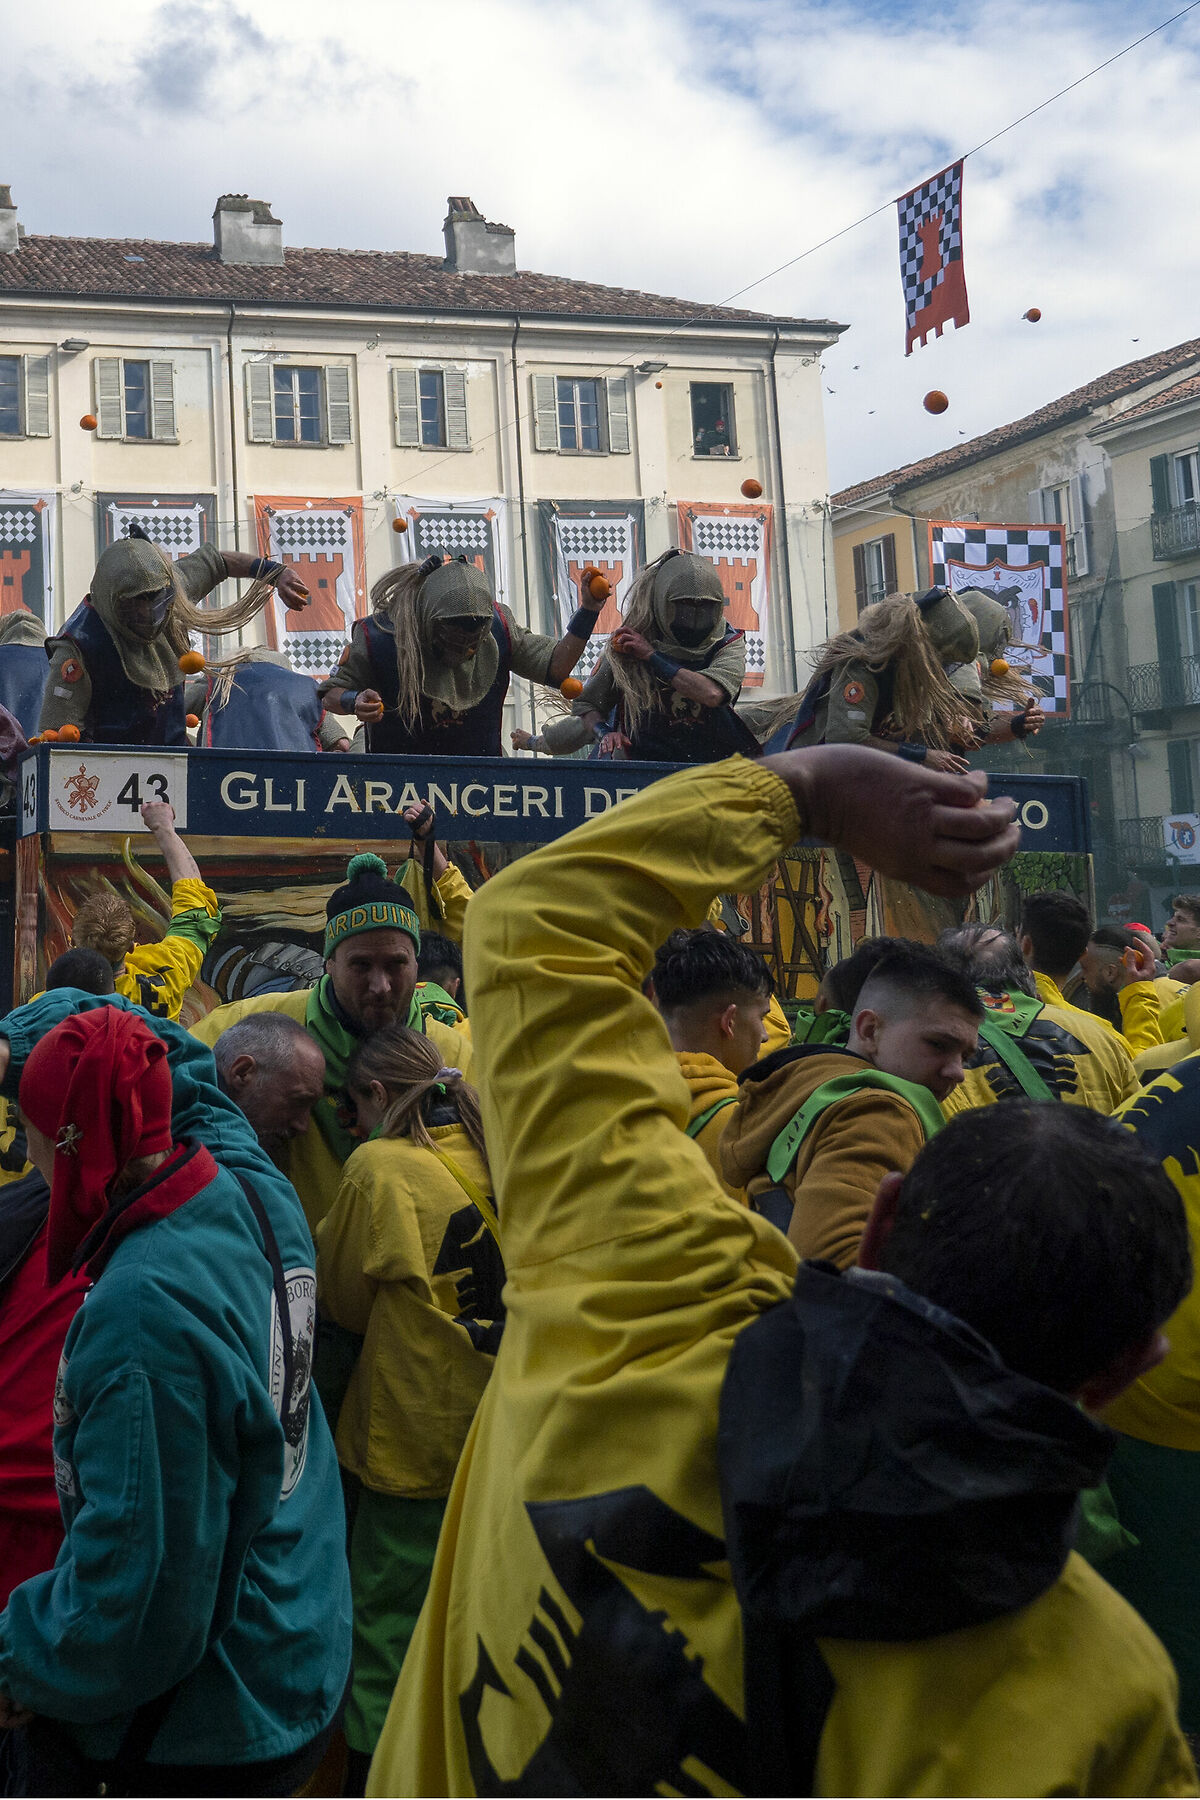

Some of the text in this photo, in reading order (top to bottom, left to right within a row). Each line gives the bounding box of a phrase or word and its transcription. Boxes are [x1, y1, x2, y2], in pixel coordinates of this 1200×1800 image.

[24, 773, 36, 818] 43
[116, 772, 171, 813] 43
[220, 770, 306, 812] GLI
[323, 774, 564, 818] ARANCERI
[327, 905, 418, 940] ARDUINI
